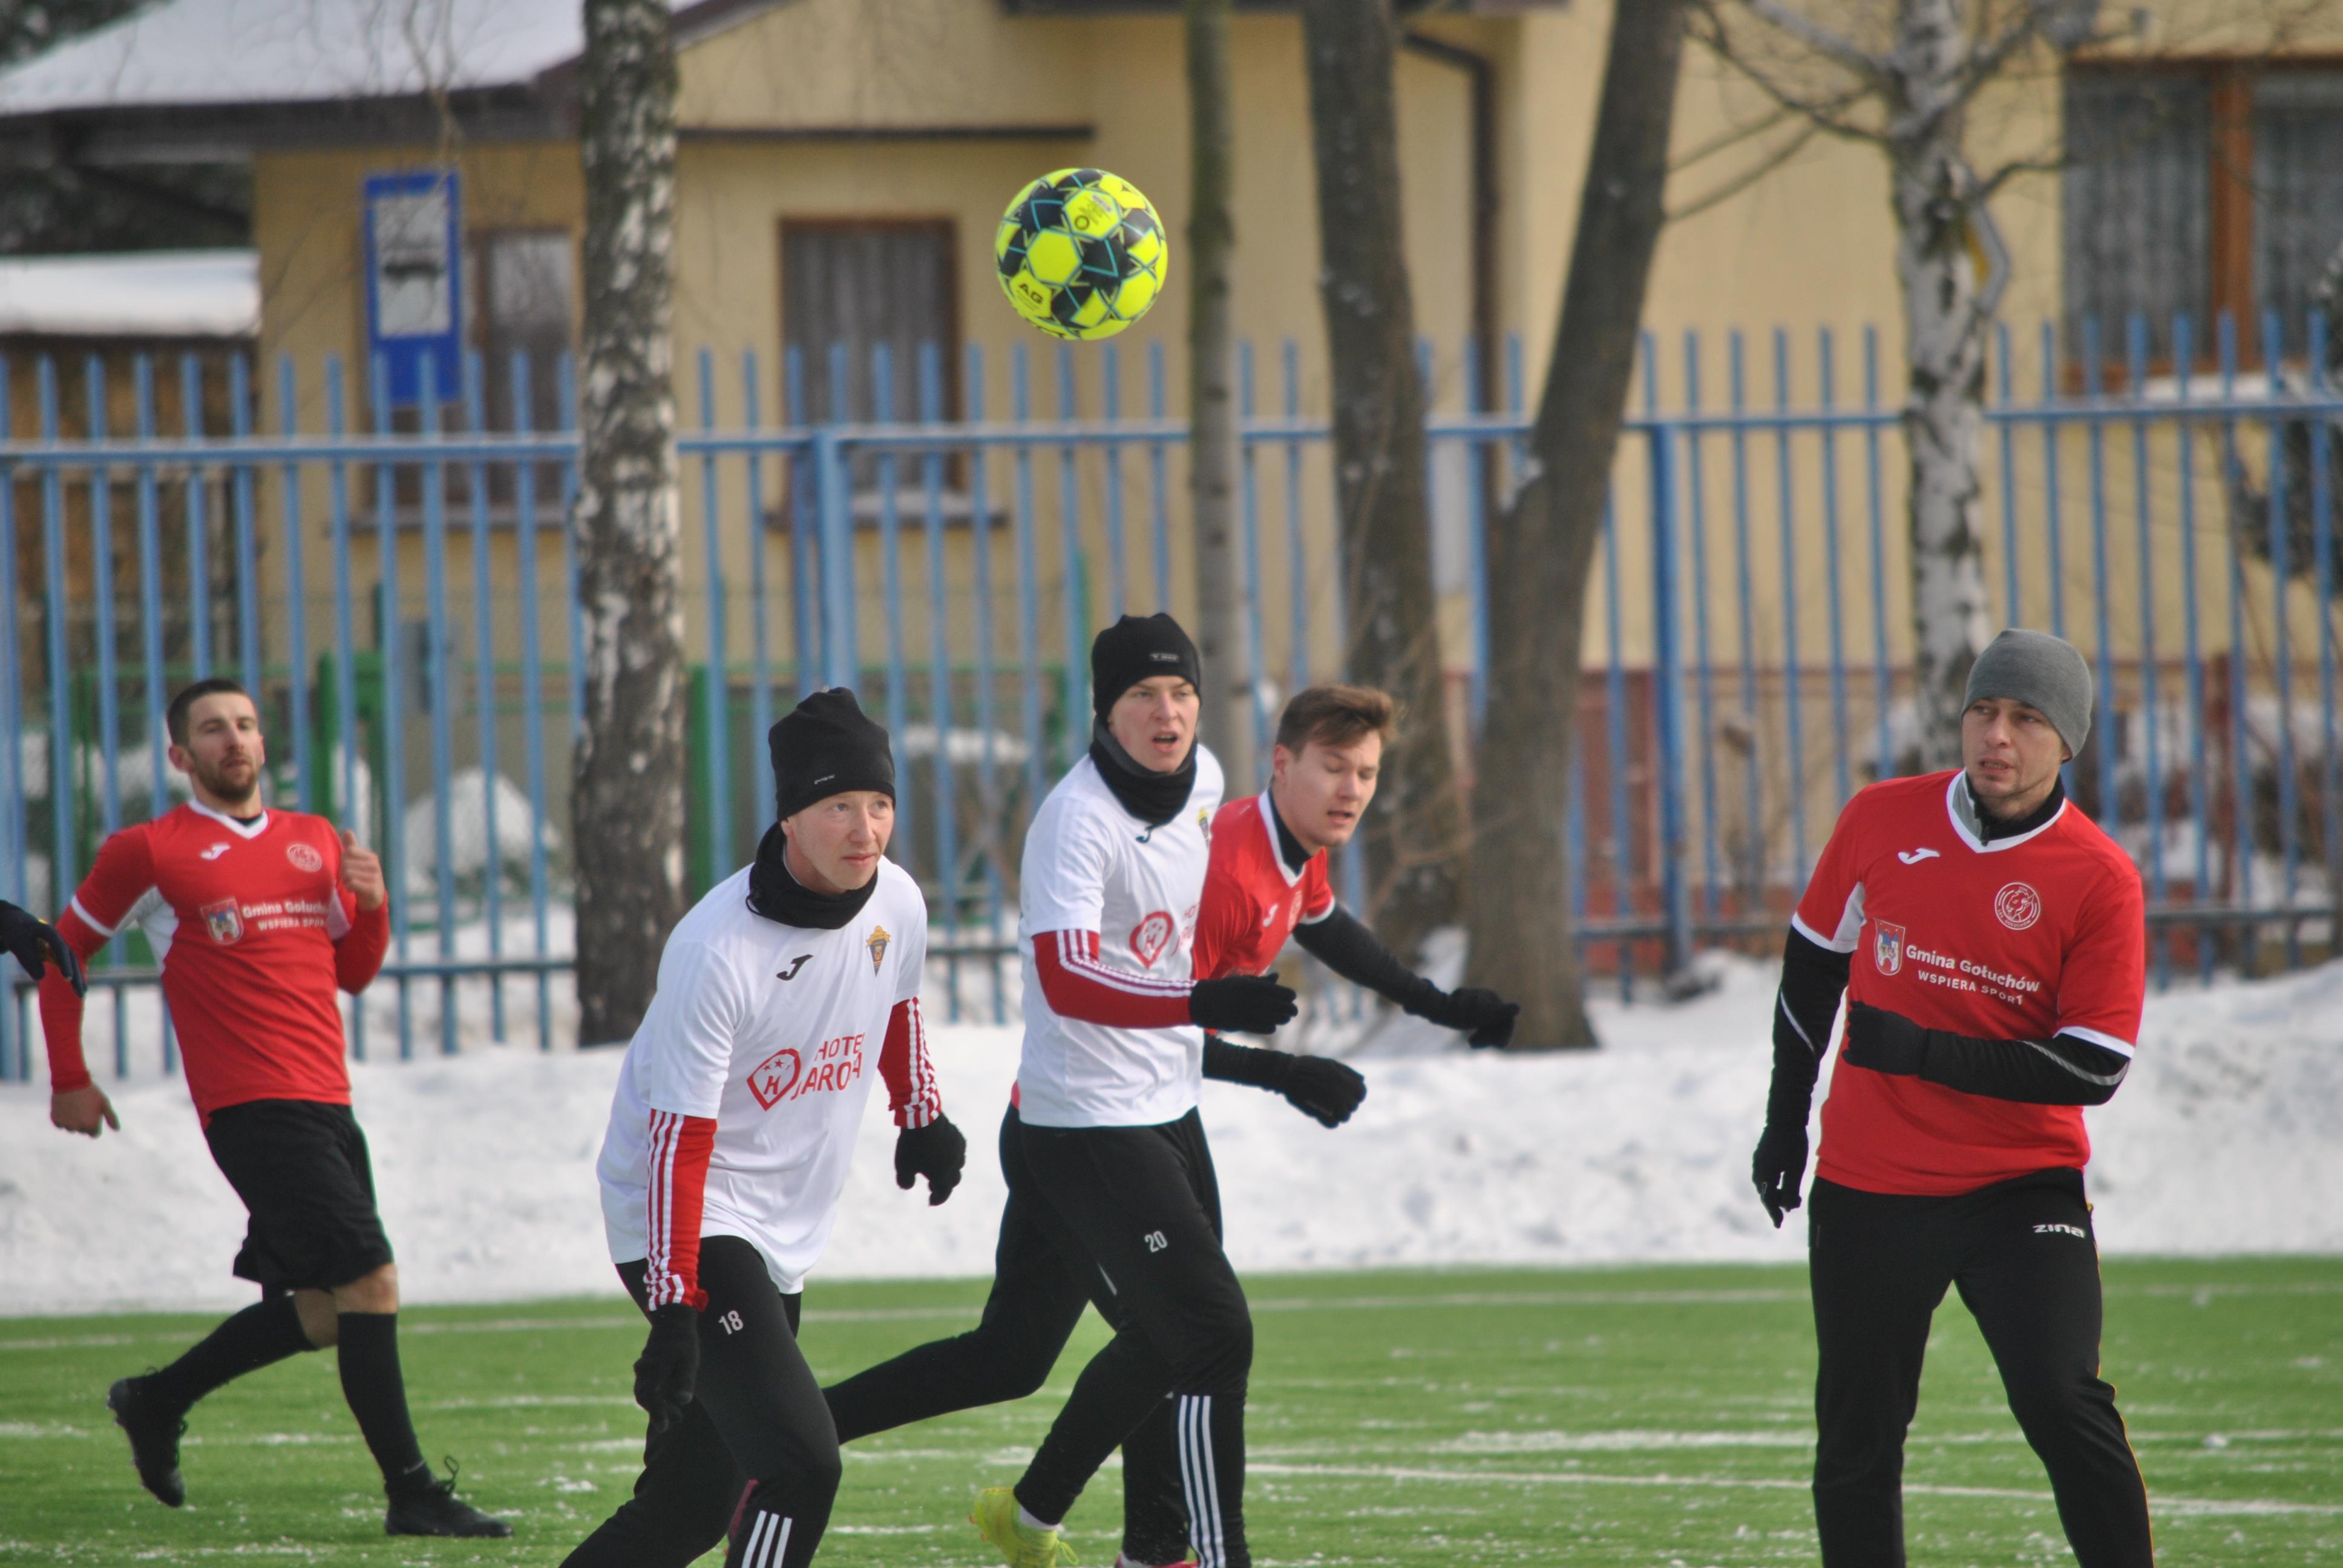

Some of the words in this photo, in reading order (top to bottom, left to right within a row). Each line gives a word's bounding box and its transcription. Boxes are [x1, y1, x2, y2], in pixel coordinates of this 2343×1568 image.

[242, 902, 283, 918] Gmina
[257, 917, 300, 932] WSPIERA
[303, 916, 325, 928] SPOR
[1906, 944, 1955, 970] Gmina
[1959, 959, 2040, 992] Gołuchów
[1918, 969, 1976, 992] WSPIERA
[1144, 1230, 1168, 1253] 20
[718, 1310, 744, 1336] 18
